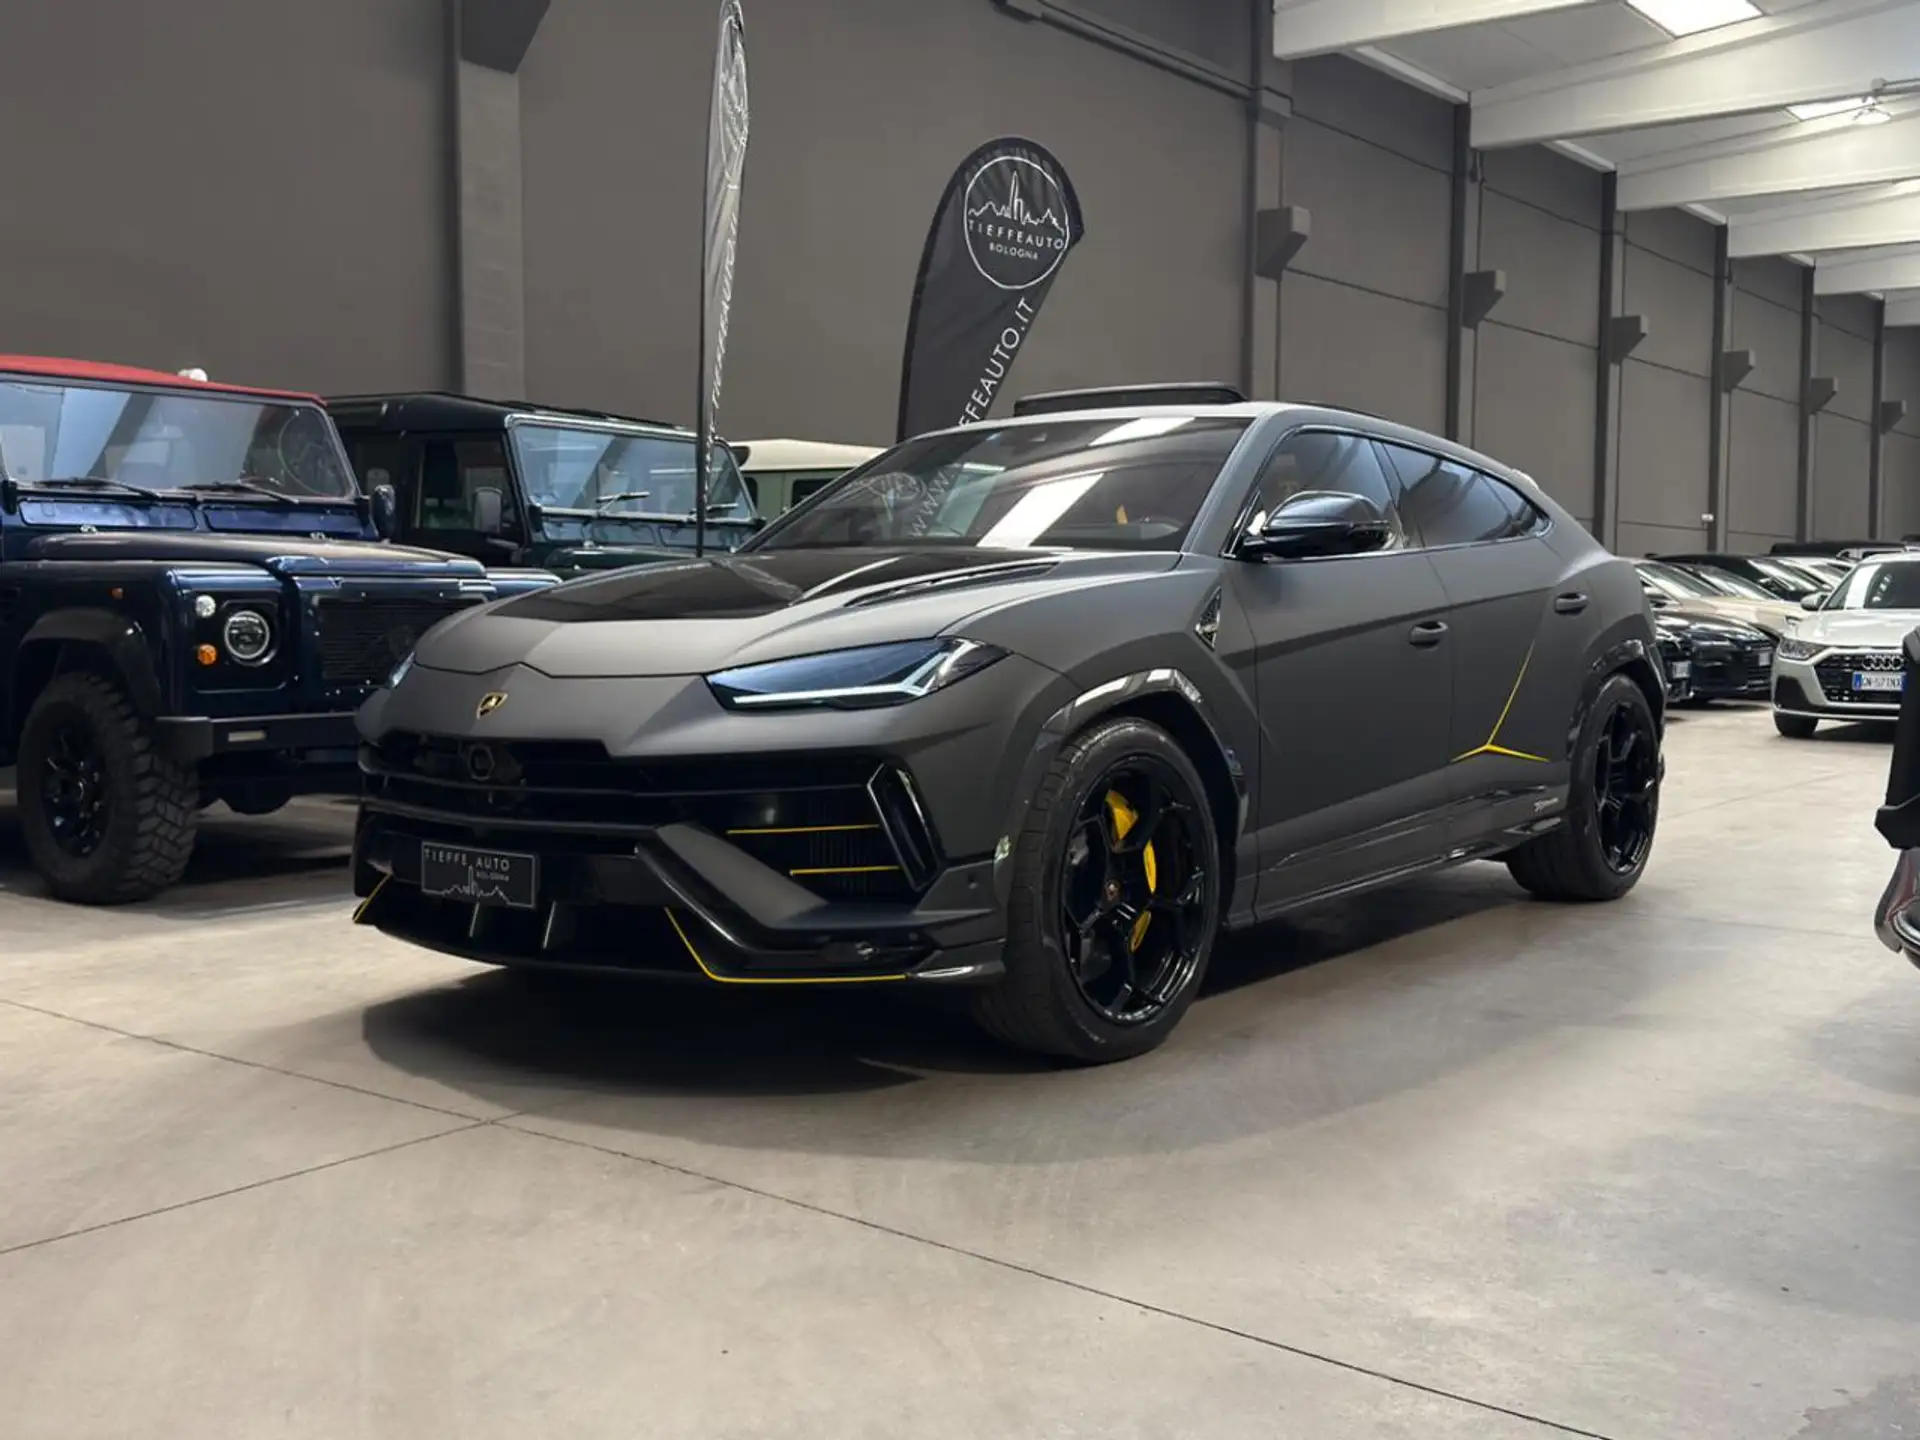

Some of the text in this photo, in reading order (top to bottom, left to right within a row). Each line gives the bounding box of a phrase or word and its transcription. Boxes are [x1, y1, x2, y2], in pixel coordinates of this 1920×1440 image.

[967, 219, 1065, 250] TIEFFEAUTO
[989, 242, 1038, 260] BOLOGNA
[475, 857, 511, 872] AUTO
